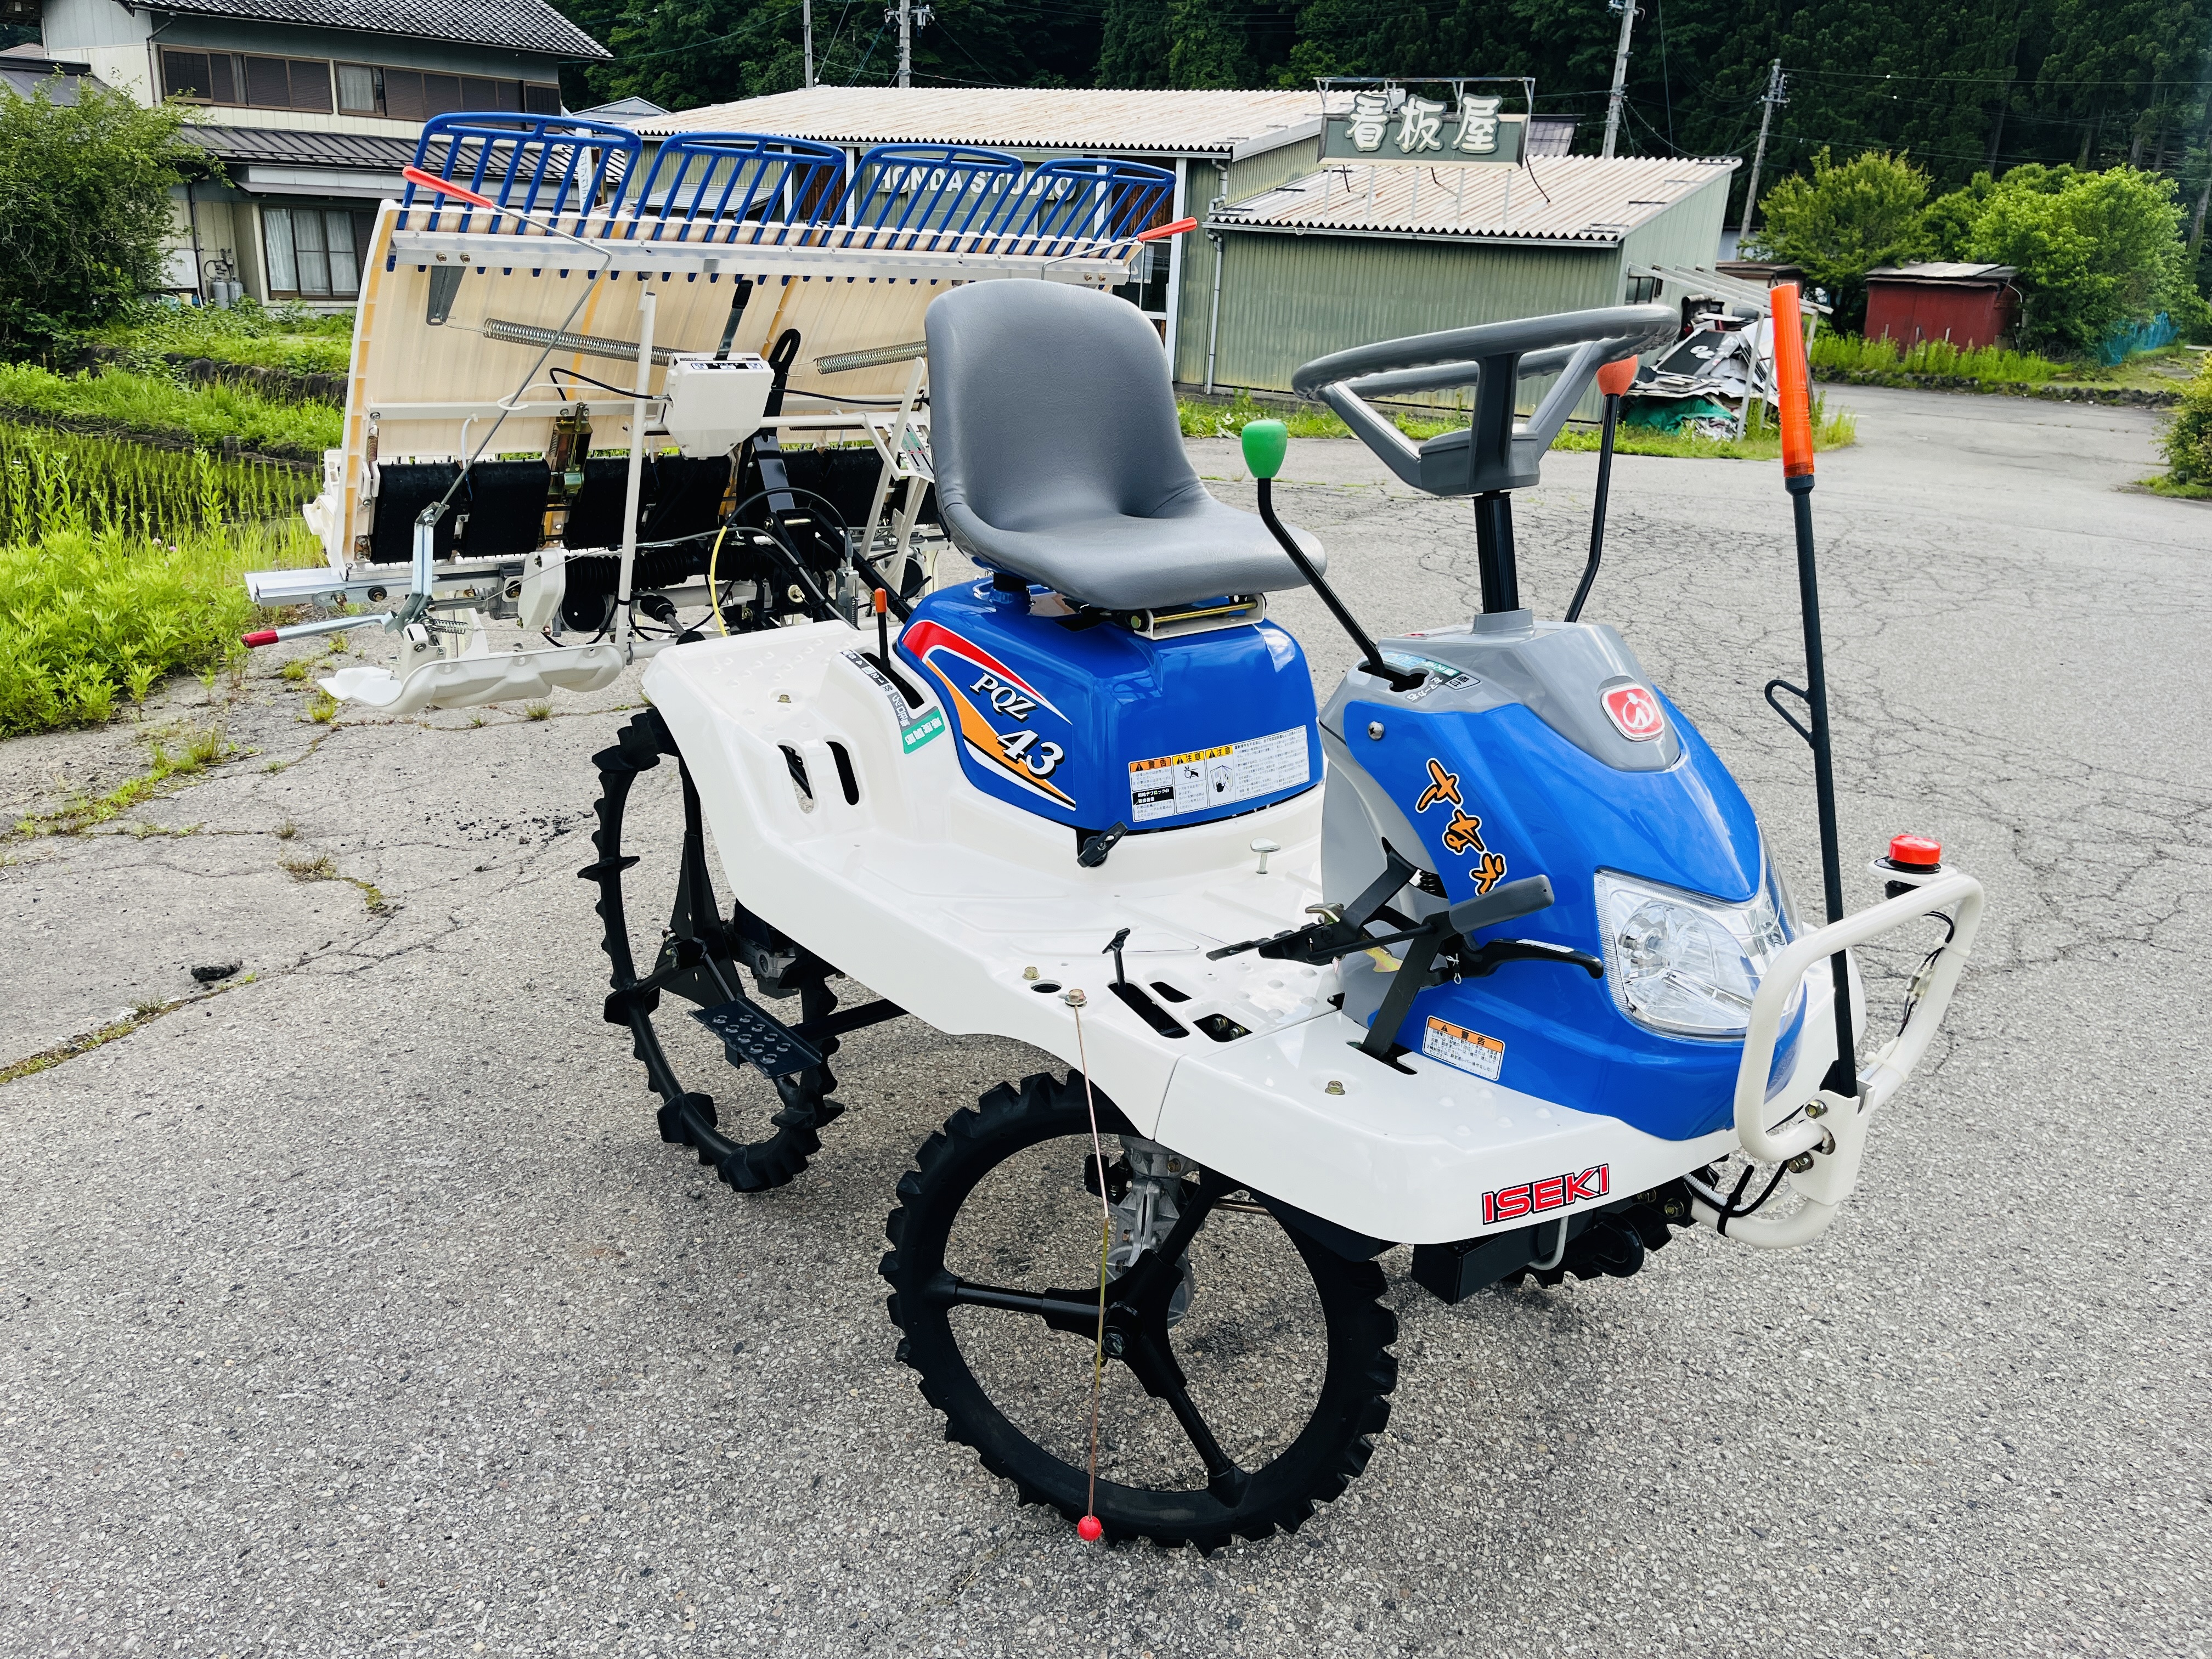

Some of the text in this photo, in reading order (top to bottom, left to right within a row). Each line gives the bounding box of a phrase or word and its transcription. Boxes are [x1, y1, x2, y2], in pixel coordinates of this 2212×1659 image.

[1346, 93, 1500, 151] 看板屋
[874, 166, 1076, 201] HONDA STUDIO
[969, 672, 1039, 723] PQZ
[996, 729, 1065, 780] 43
[1186, 753, 1201, 762] 注意
[1217, 747, 1231, 758] 注意
[1481, 1163, 1609, 1225] ISEKI
